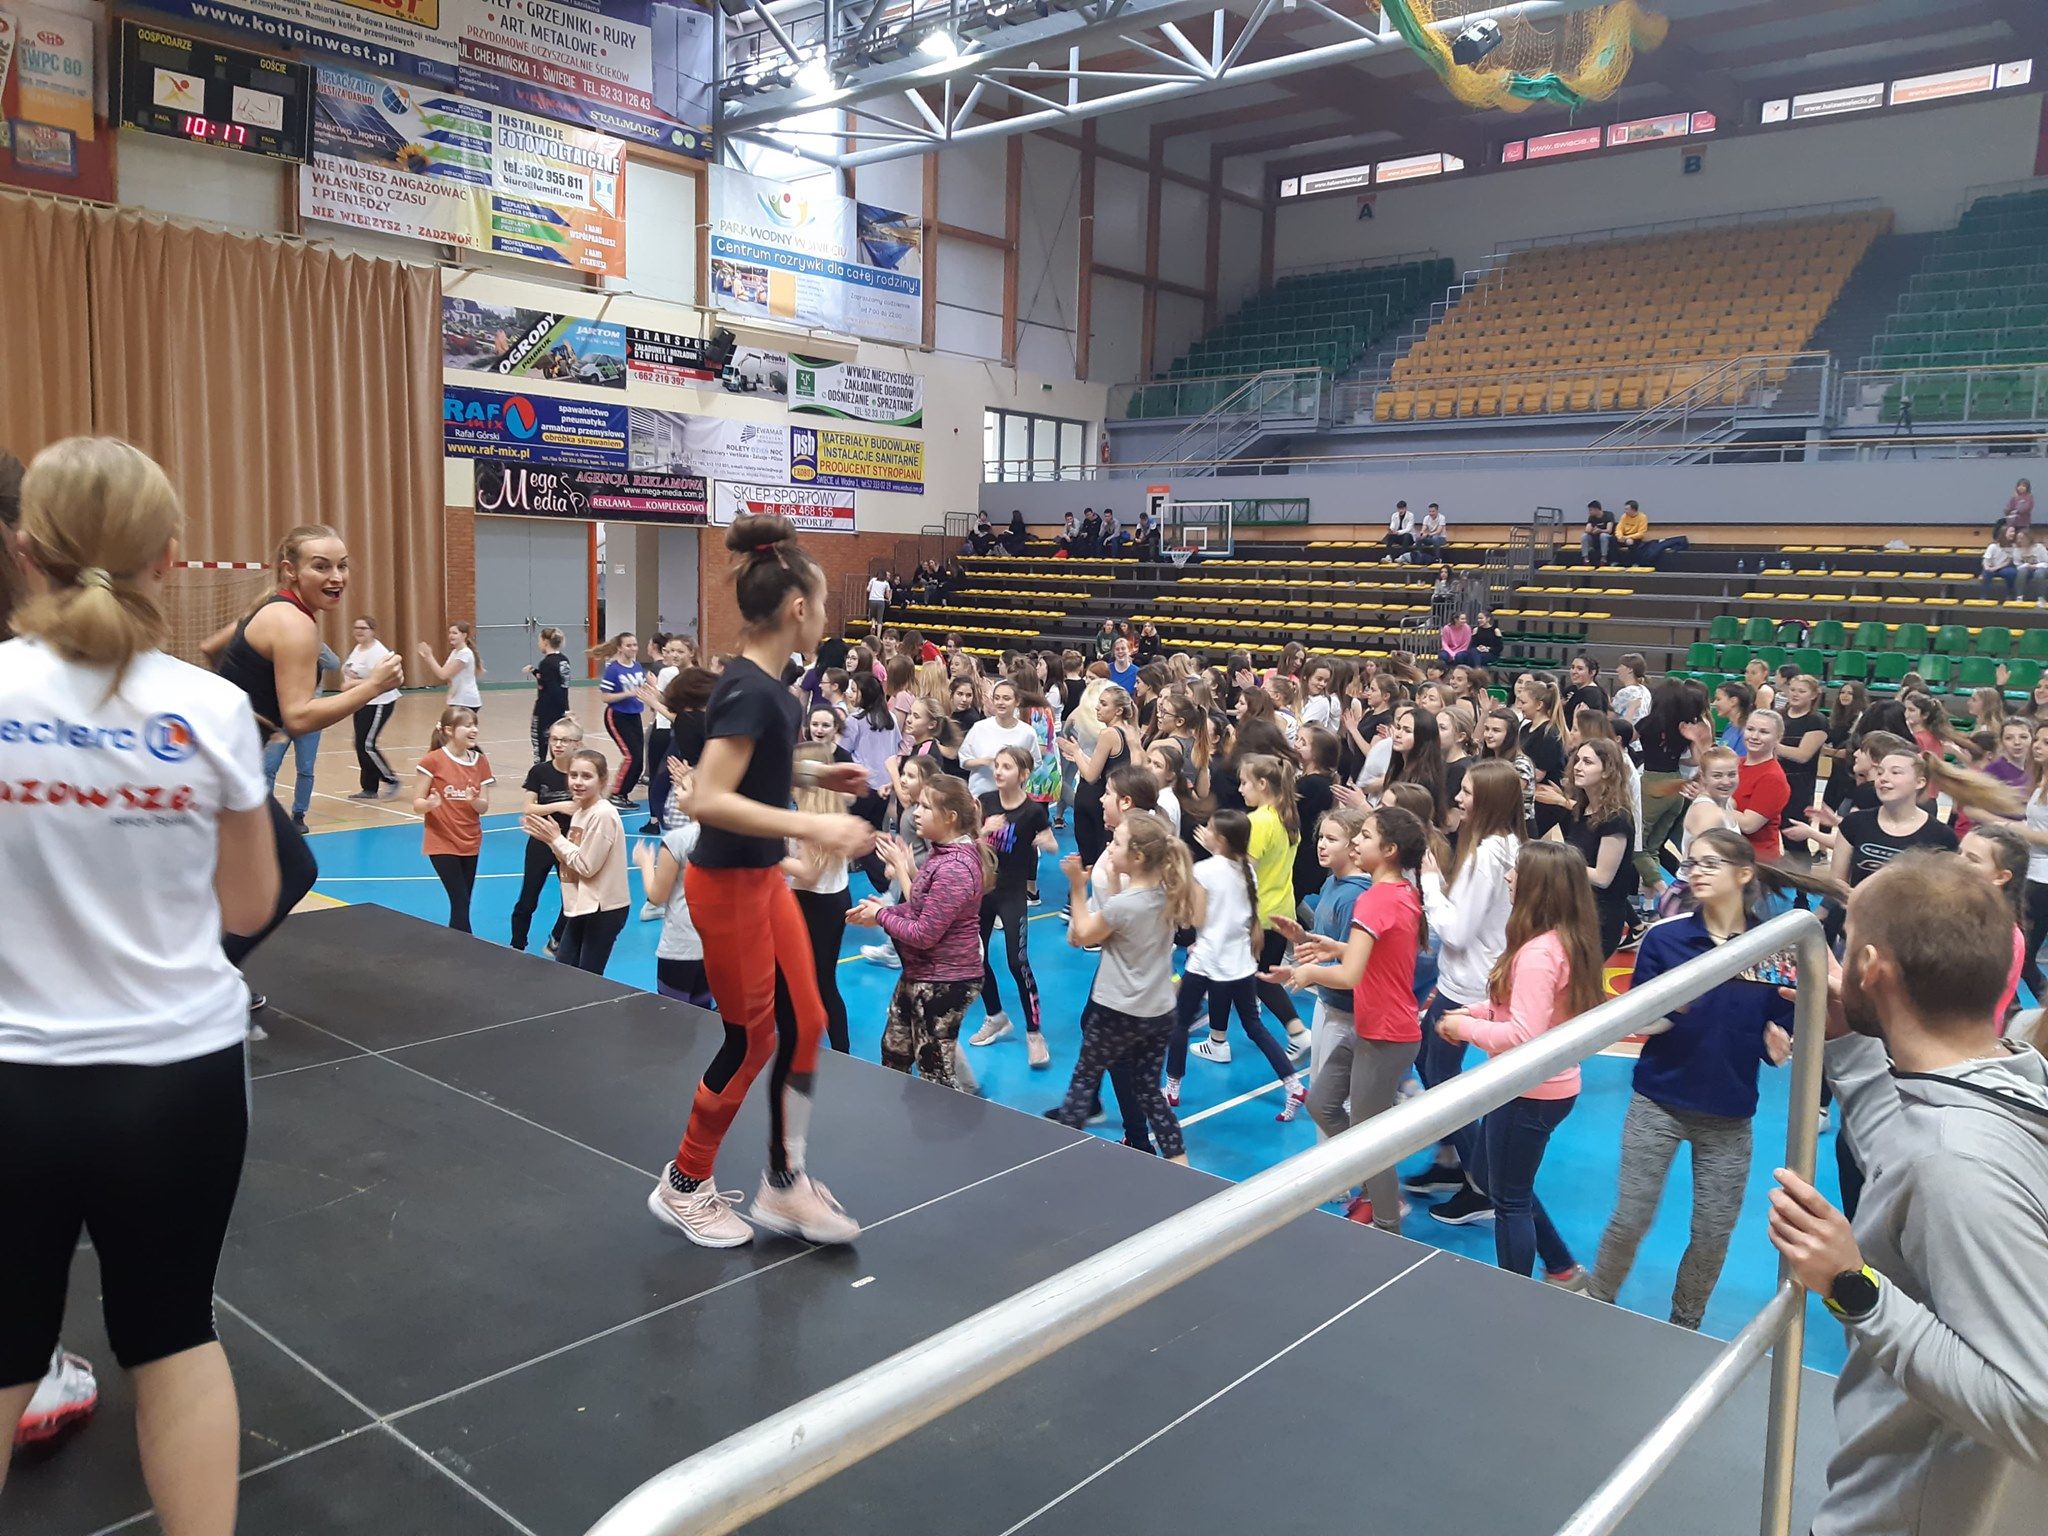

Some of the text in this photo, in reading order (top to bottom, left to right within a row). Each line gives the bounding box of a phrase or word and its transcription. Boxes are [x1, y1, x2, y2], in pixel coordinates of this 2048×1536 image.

[191, 3, 396, 65] www.kotloinwest.pl
[305, 11, 336, 26] Remonty
[364, 28, 415, 48] przemysłowych
[356, 13, 458, 49] Budowa konstrukcji stalowych
[500, 14, 598, 57] ART. METALOWE
[526, 1, 637, 50] GRZEJNIKI RURY
[138, 28, 193, 51] GOSPODARZE
[467, 25, 630, 82] PRZYDOMOWE OCZYSZCZALNIE ŚCIEKÓW
[260, 58, 288, 75] GOŚCIE
[458, 42, 473, 58] UL.
[474, 47, 530, 75] CHEŁMIŃSKA
[543, 67, 577, 89] ŚWIECIE
[600, 86, 612, 98] 52
[612, 90, 624, 103] 33
[625, 92, 640, 107] 126
[640, 96, 652, 111] 43
[185, 116, 246, 144] 10:17
[498, 113, 564, 141] INSTALACJE
[590, 111, 660, 138] STALMARK
[1684, 155, 1701, 173] B
[312, 158, 468, 201] NIE MUSISZ ANGAŻOWAĆ
[503, 174, 584, 202] biuro@lumifil.com
[524, 165, 545, 181] 502
[546, 171, 566, 187] 955
[567, 177, 583, 190] 811
[312, 172, 427, 206] WŁASNEGO CZASU
[312, 187, 391, 213] I PIENIĘDZY
[1358, 203, 1373, 220] A
[311, 205, 335, 219] NIE
[340, 210, 401, 232] WIERZYSZ
[418, 226, 473, 247] ZADZWOŃ
[719, 219, 749, 236] PARK
[750, 226, 793, 246] WODNY
[500, 238, 544, 252] PROFESJONALNY
[716, 238, 919, 296] Centrum rozrywki dla całej rodziny!
[499, 312, 557, 375] OGRODY
[634, 329, 710, 350] TRANSPOR
[670, 348, 703, 361] ROZŁADUN
[638, 371, 654, 381] 662
[655, 373, 670, 384] 219
[671, 376, 686, 387] 392
[846, 365, 914, 387] WYWÓZ NIECZYSTOŚCI
[844, 378, 914, 400] ZAKŁADANIE OGRODÓW
[444, 398, 501, 422] RAF
[558, 405, 610, 418] spawalnictwo
[827, 389, 869, 406] ODŚNIEŻANIE
[876, 396, 914, 413] SPRZĄTANIE
[541, 423, 626, 439] armatura przemysłowa
[561, 415, 607, 427] pneumatyka
[756, 427, 783, 436] EWAMAR
[455, 428, 500, 441] Rafał Górski
[544, 434, 622, 448] obróbka skrawaniem
[793, 430, 816, 457] psb
[822, 432, 920, 454] MATERIAŁY BUDOWLANE
[447, 442, 531, 460] www.raf-mix.pl
[726, 443, 750, 453] ROLETY
[769, 448, 783, 456] NOC
[823, 447, 919, 467] INSTALACJE SANITARNE
[575, 470, 704, 491] AGENCJA REKLAMOWA
[820, 460, 922, 480] PRODUCENT STYROPIANU
[623, 487, 705, 500] www.mega-media.com.pl
[733, 484, 837, 505] SKLEP SPORTOWY
[763, 503, 834, 517] tel. 605 468 155
[1151, 496, 1164, 515] F
[787, 517, 834, 528] NSPORT.PL
